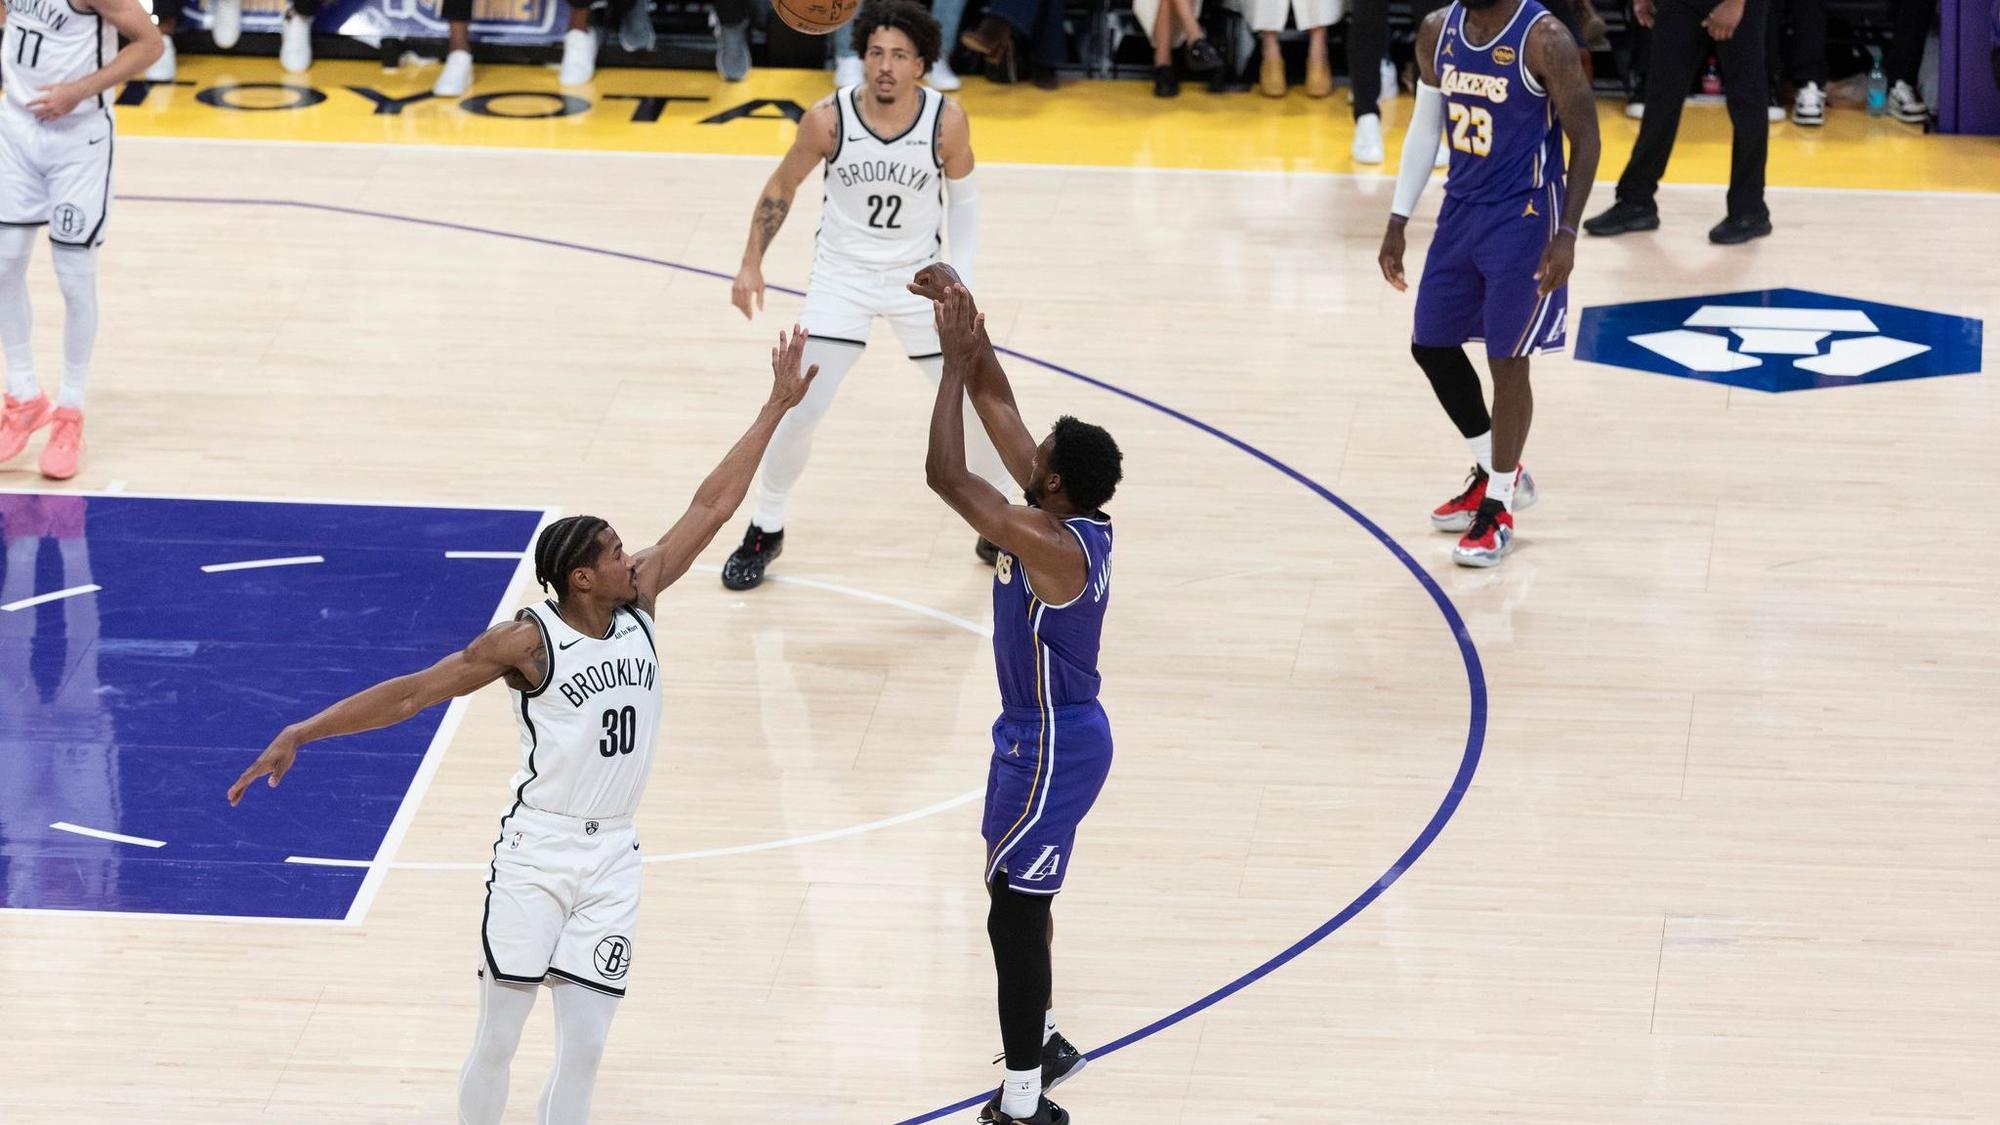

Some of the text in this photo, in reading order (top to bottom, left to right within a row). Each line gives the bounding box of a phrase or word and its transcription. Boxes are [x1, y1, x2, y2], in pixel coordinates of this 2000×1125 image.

[16, 26, 44, 68] 77
[114, 80, 808, 125] TOYOTA
[1440, 63, 1509, 103] LAKERS
[1448, 102, 1493, 157] 23
[837, 160, 932, 192] BROOKLYN
[867, 194, 902, 229] 22
[559, 657, 656, 708] BROOKLYN
[600, 705, 636, 758] 30
[1016, 844, 1060, 882] LA
